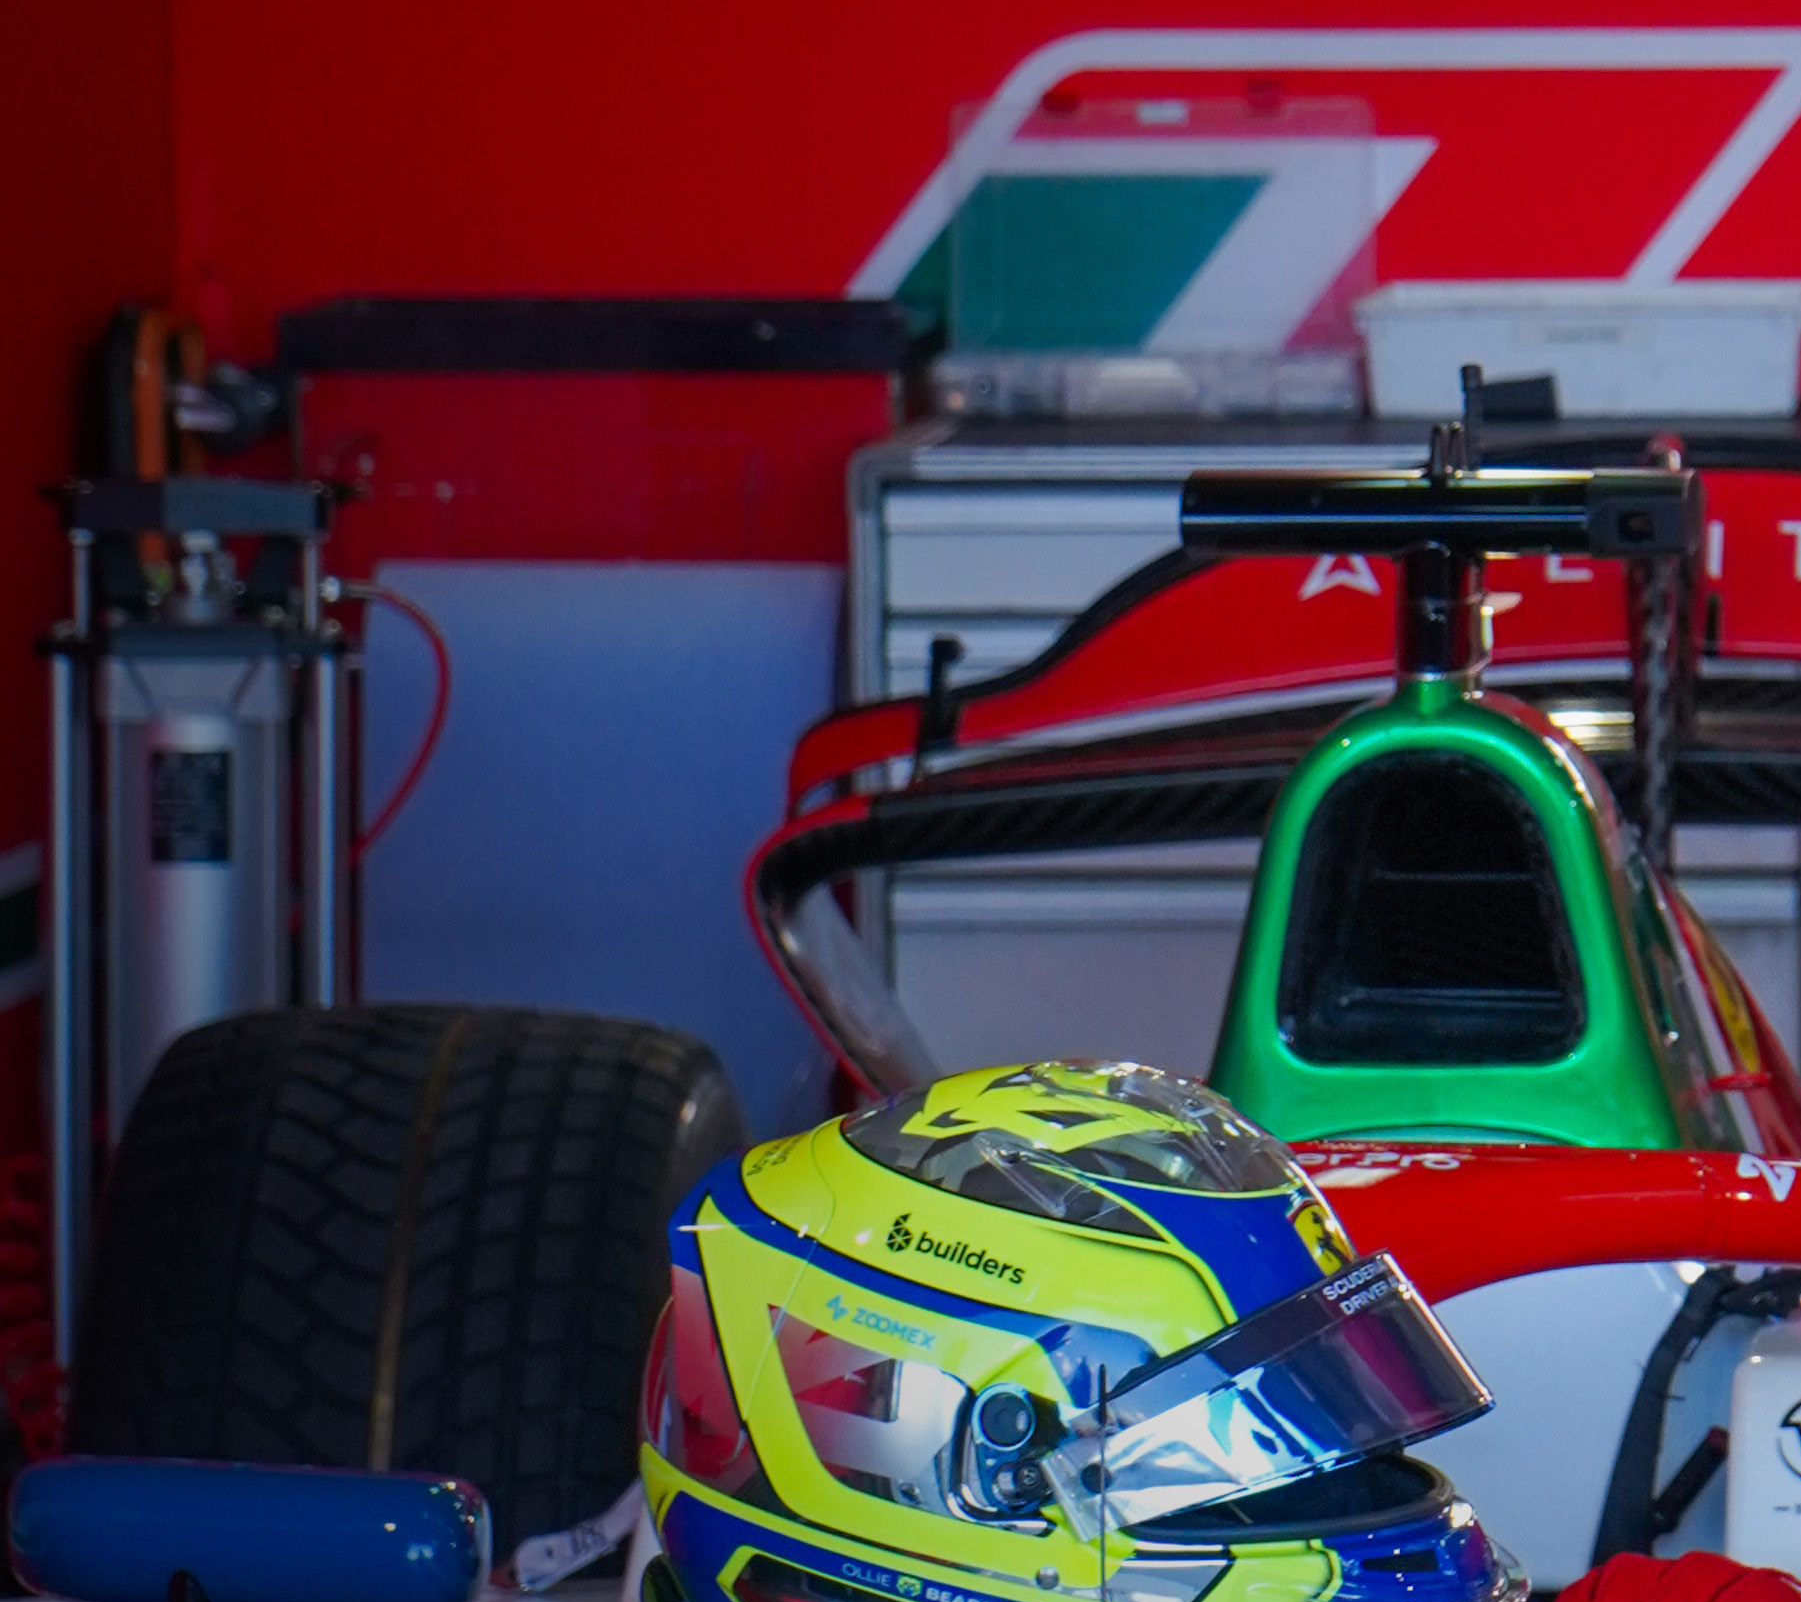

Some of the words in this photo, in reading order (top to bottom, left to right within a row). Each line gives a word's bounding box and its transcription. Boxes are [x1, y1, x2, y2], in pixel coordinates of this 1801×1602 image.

[915, 1232, 1026, 1285] builders
[852, 1307, 937, 1351] ZOOMEX
[842, 1562, 892, 1588] OLLIE
